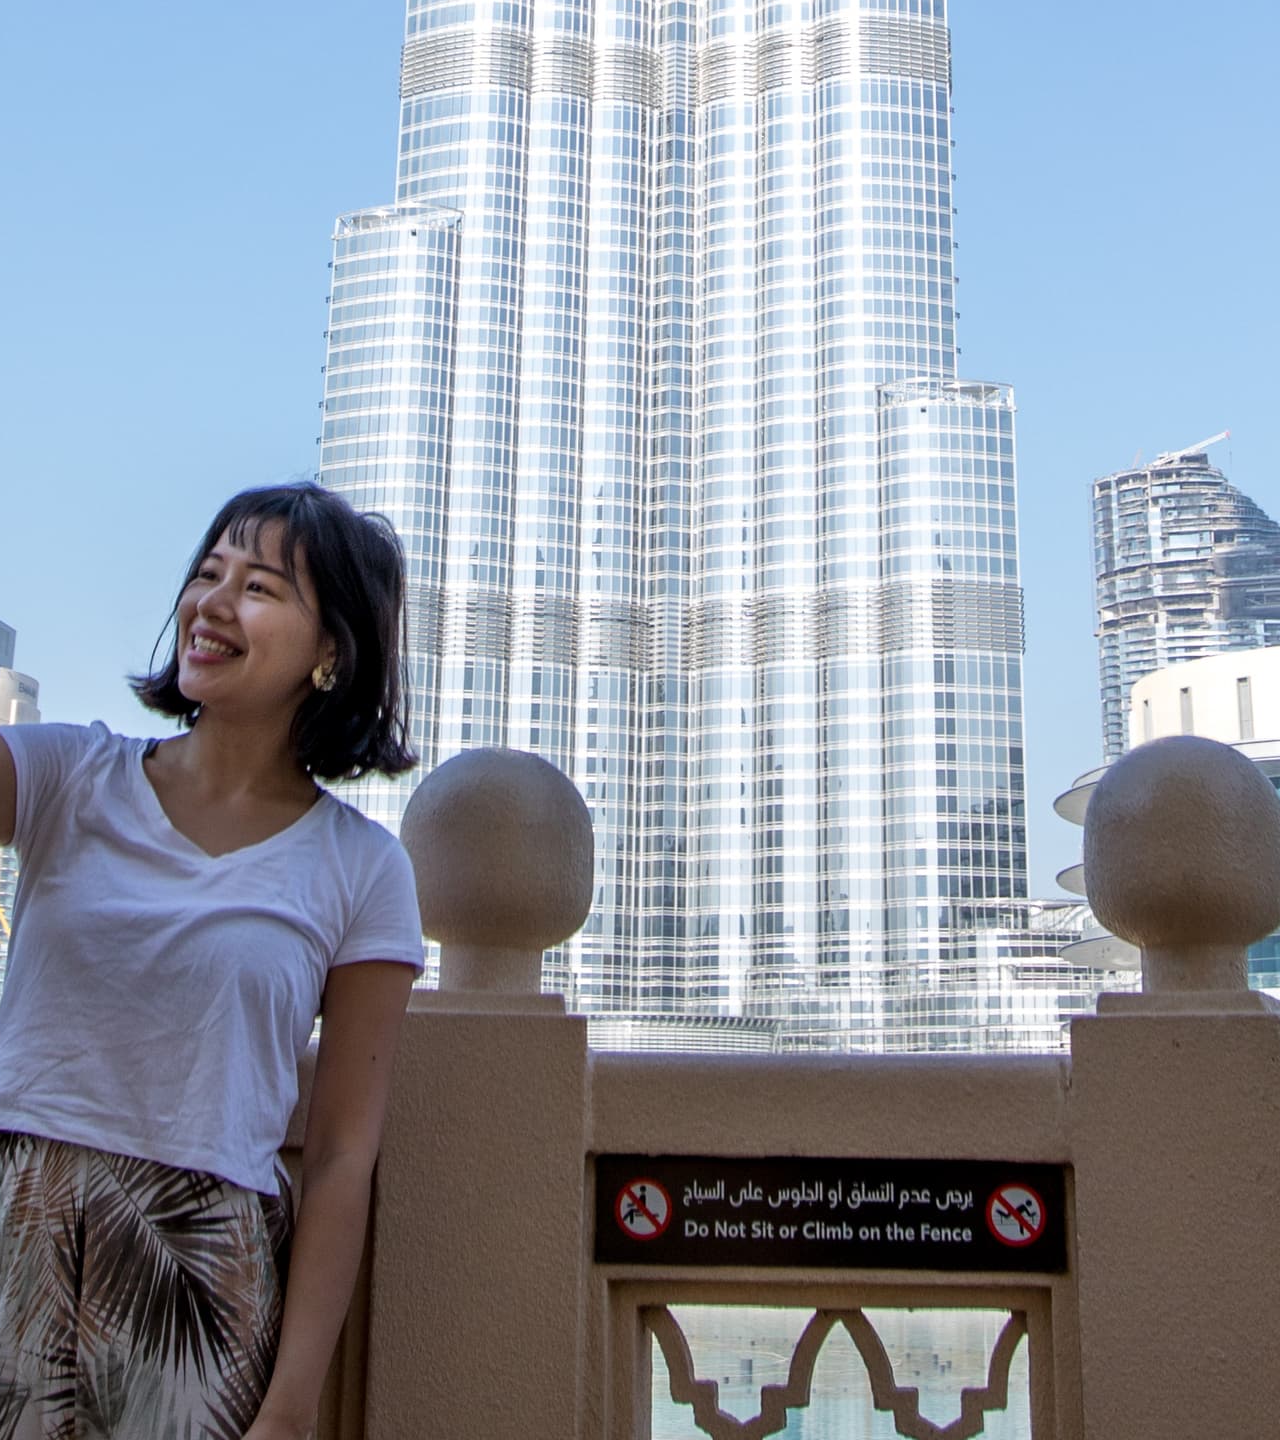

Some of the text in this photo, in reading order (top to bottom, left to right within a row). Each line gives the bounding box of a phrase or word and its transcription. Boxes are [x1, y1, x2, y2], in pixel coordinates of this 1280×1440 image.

[682, 1179, 725, 1208] السياج
[729, 1180, 763, 1207] على
[767, 1180, 823, 1208] الجلوس
[846, 1181, 895, 1209] التسلق
[898, 1189, 931, 1210] عدم
[935, 1189, 974, 1211] يرجى
[684, 1220, 972, 1242] Do Not Sit or Climb on the Fence
